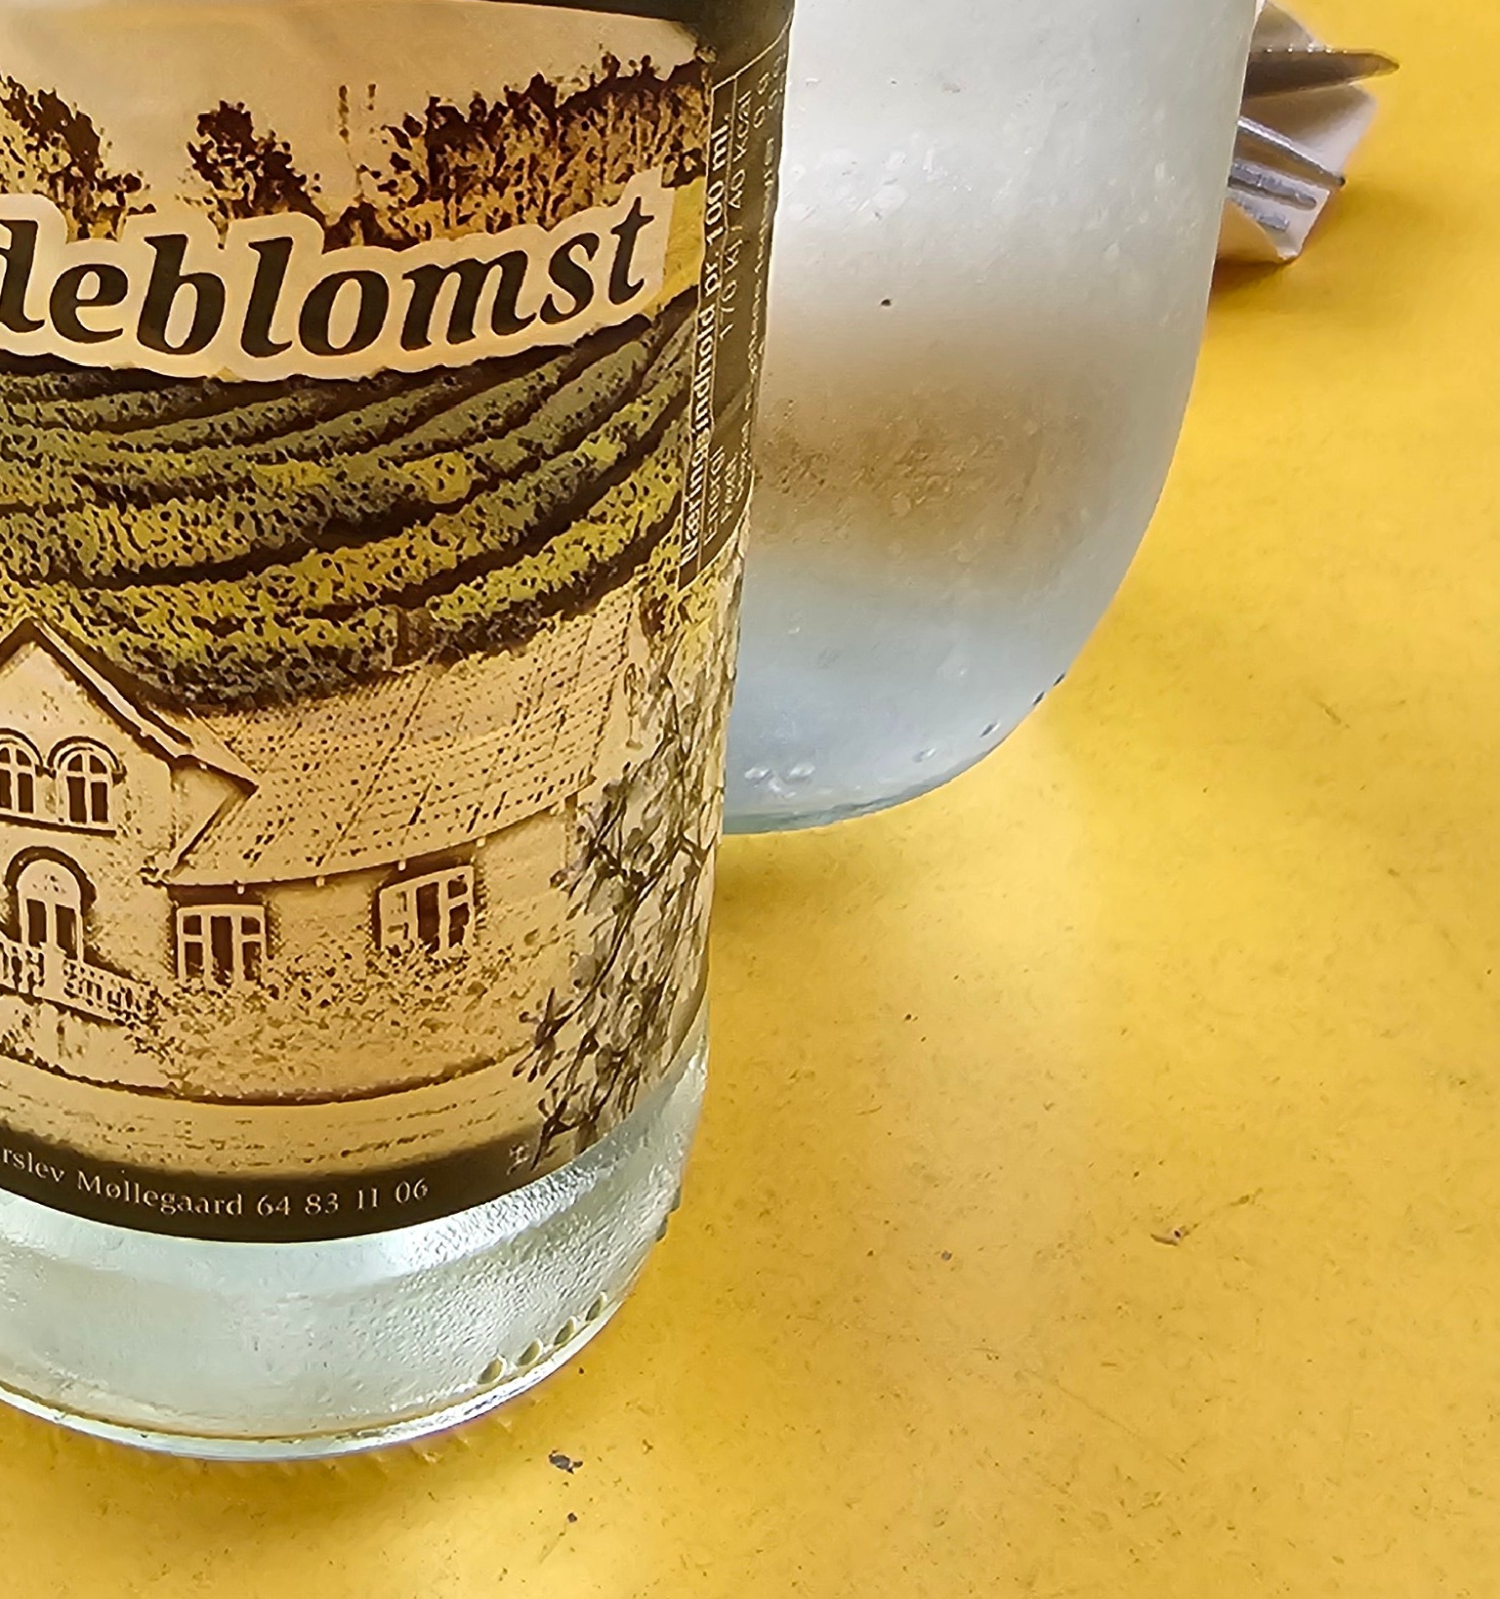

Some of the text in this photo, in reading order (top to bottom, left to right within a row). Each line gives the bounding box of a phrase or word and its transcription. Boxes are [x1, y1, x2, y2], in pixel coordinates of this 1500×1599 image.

[705, 180, 725, 246] 100
[77, 1169, 243, 1216] Møllegaard
[257, 1194, 291, 1217] 64
[304, 1191, 339, 1215] 83
[356, 1187, 379, 1210] 11
[395, 1177, 429, 1205] 06
